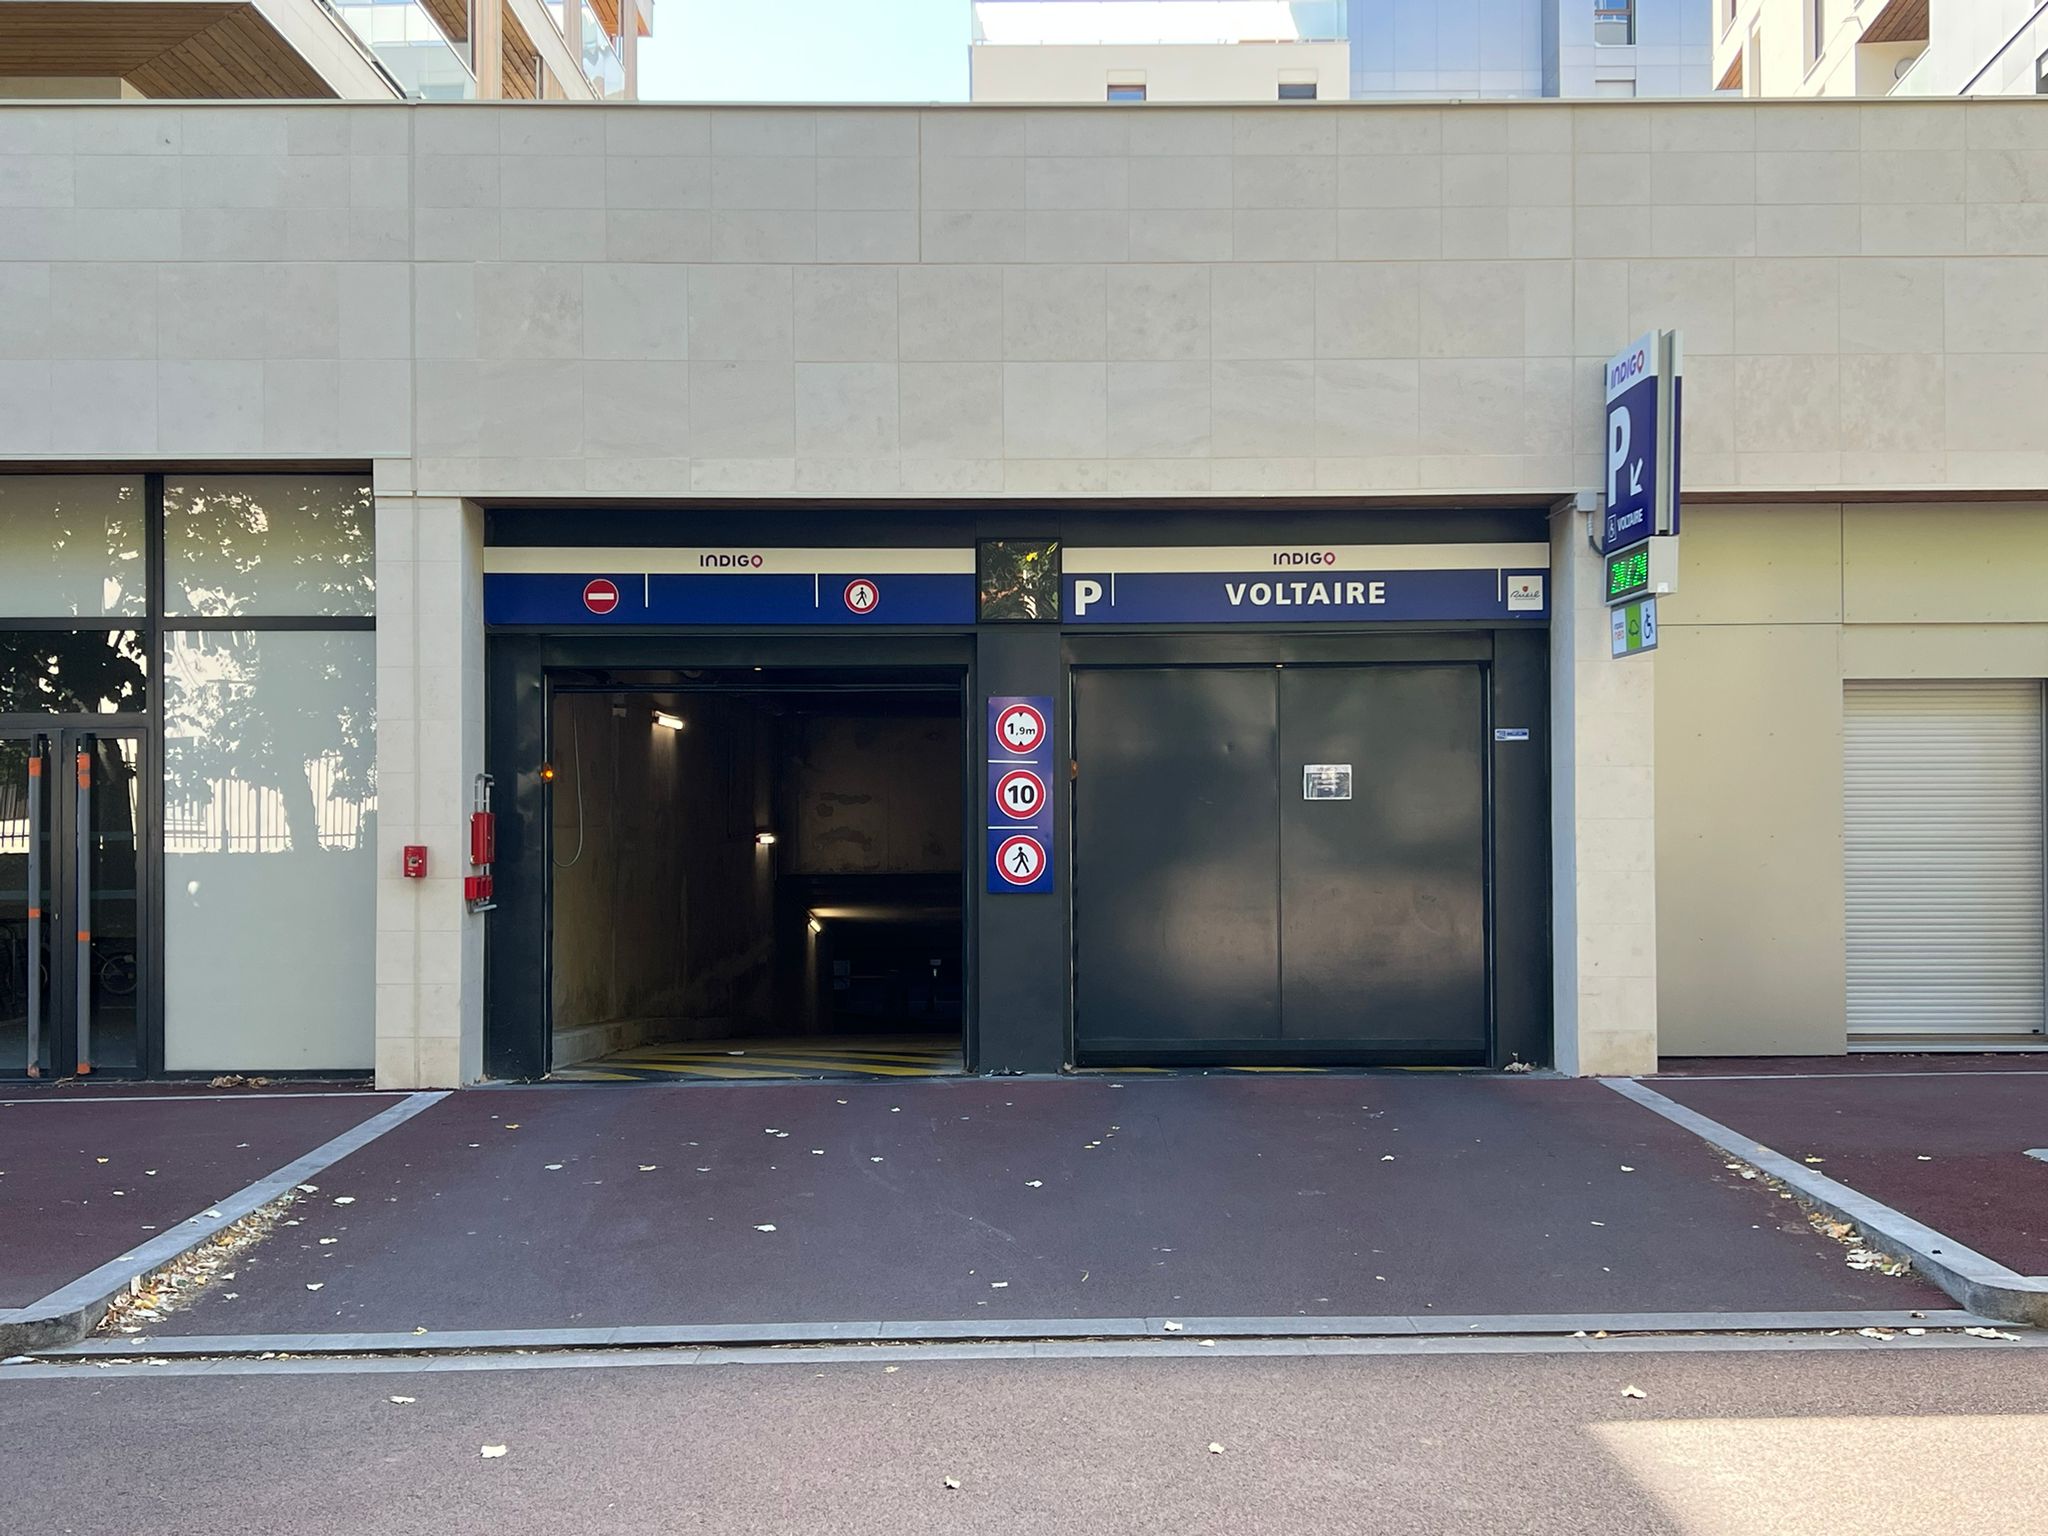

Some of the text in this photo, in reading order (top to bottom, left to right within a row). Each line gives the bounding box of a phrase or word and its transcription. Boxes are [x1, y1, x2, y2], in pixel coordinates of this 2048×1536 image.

[1610, 349, 1645, 390] INDIGO
[1608, 405, 1631, 508] P
[1616, 507, 1643, 532] VOLTAIRE
[700, 554, 763, 568] INDIGO
[1273, 552, 1336, 566] INDIGO
[1075, 580, 1103, 616] P
[1225, 581, 1386, 606] VOLTAIRE
[1007, 722, 1036, 736] 1,9m
[1007, 785, 1035, 804] 10
